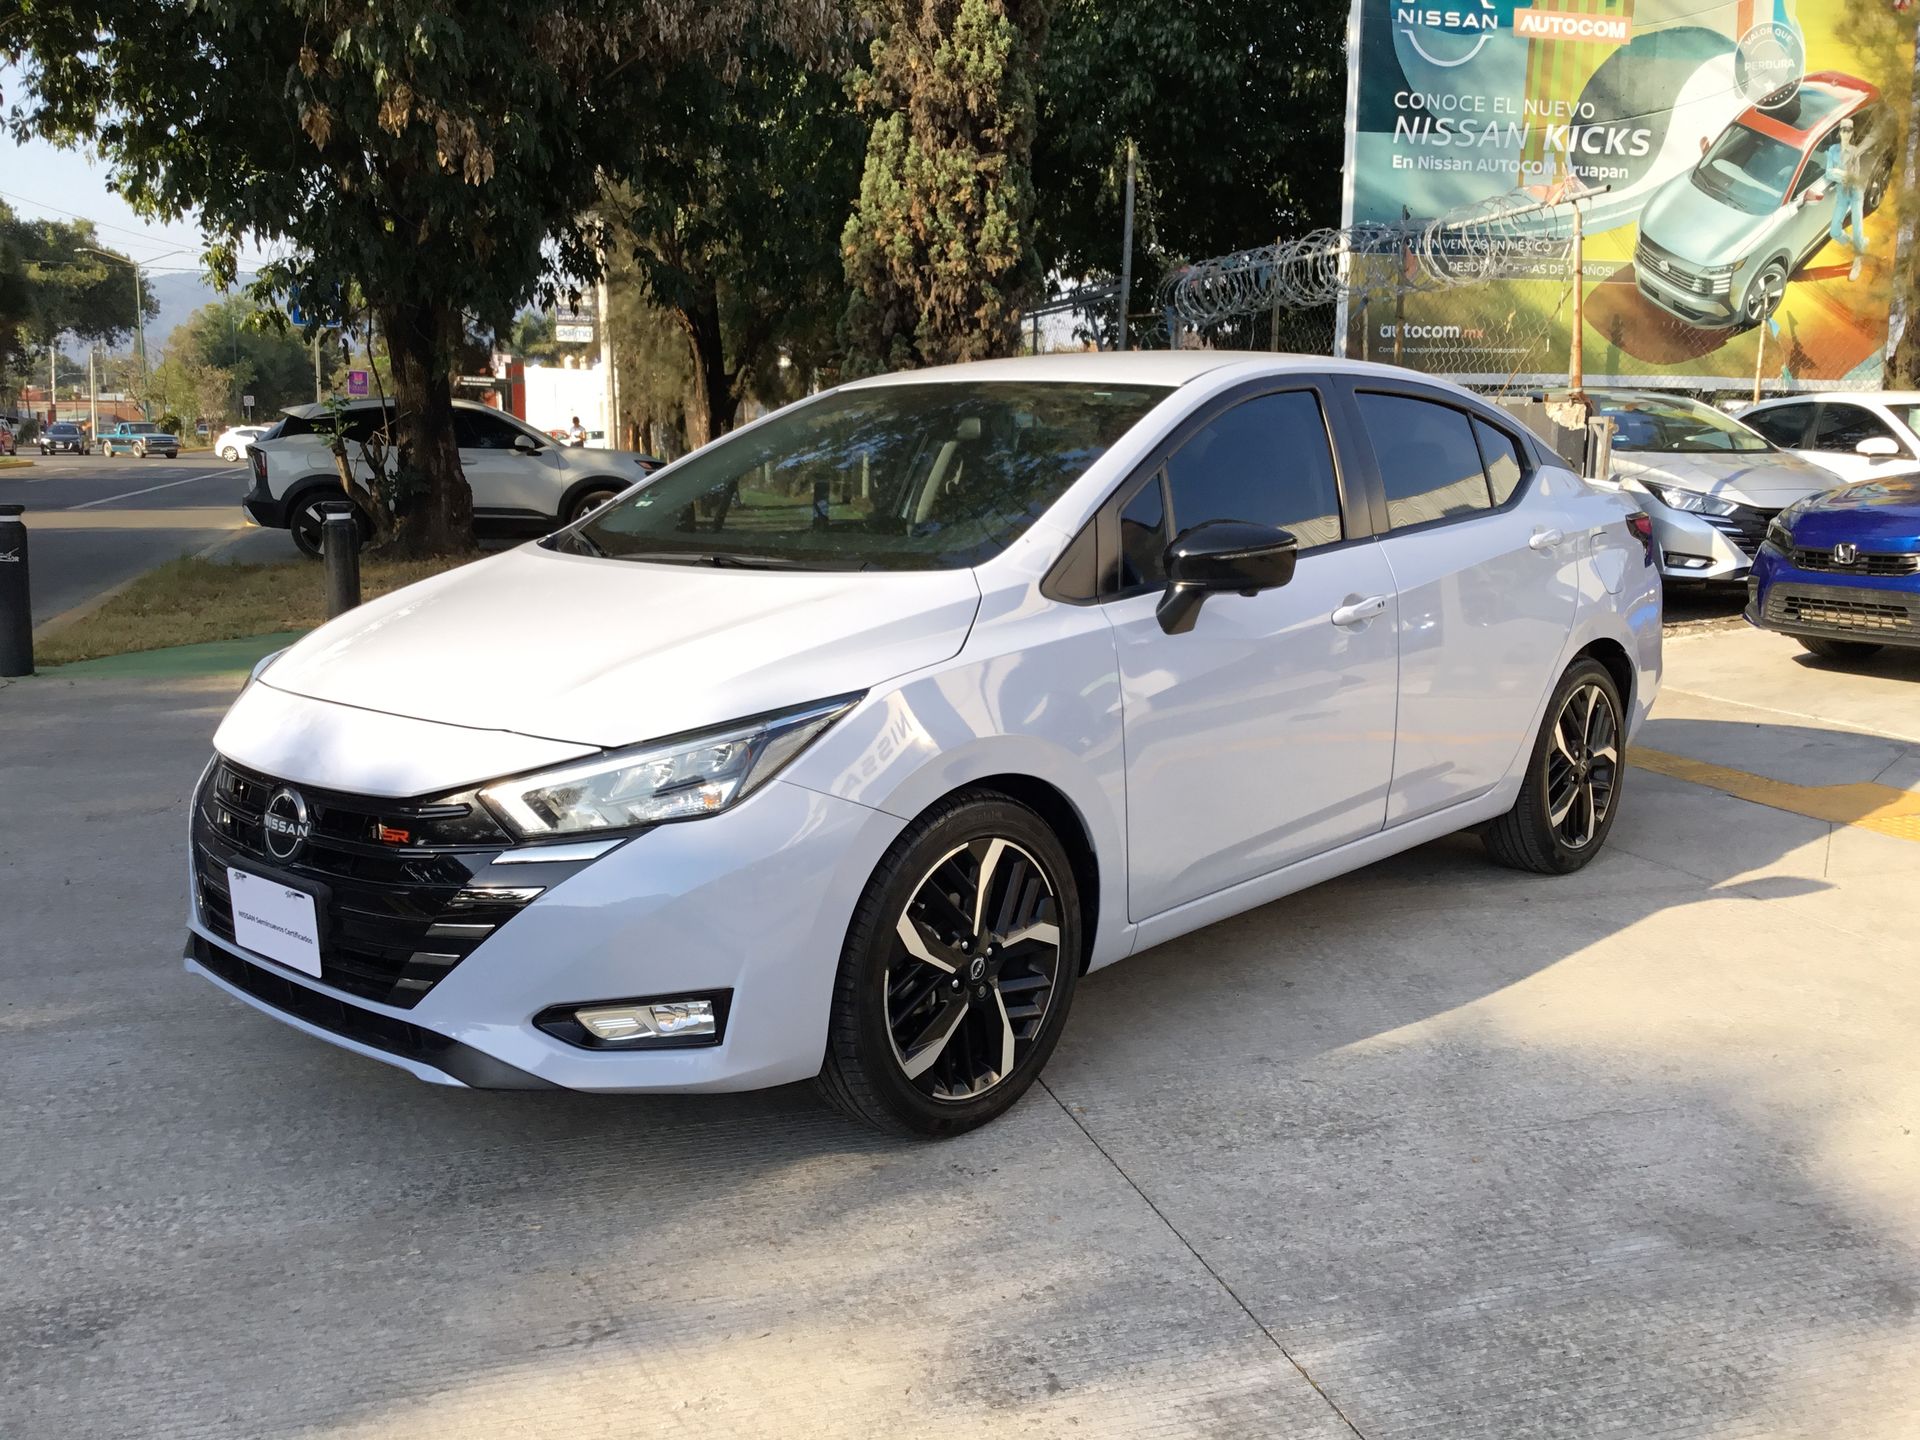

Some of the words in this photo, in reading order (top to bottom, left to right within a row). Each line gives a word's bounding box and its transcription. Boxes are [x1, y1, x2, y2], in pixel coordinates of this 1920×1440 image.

[1397, 8, 1499, 30] NISSAN
[1519, 15, 1627, 39] AUTOCOM
[1744, 58, 1796, 72] PERDURA
[1393, 91, 1486, 113] CONOCE
[1493, 97, 1517, 115] EL
[1524, 98, 1595, 119] NUEVO
[1392, 115, 1531, 150] NISSAN
[1543, 123, 1653, 157] KICKS
[1392, 154, 1414, 169] En
[1417, 155, 1473, 172] Nissan
[1476, 158, 1557, 175] AUTOCOM
[1550, 264, 1565, 275] DE
[263, 816, 309, 838] NISSAN
[382, 827, 410, 844] SR
